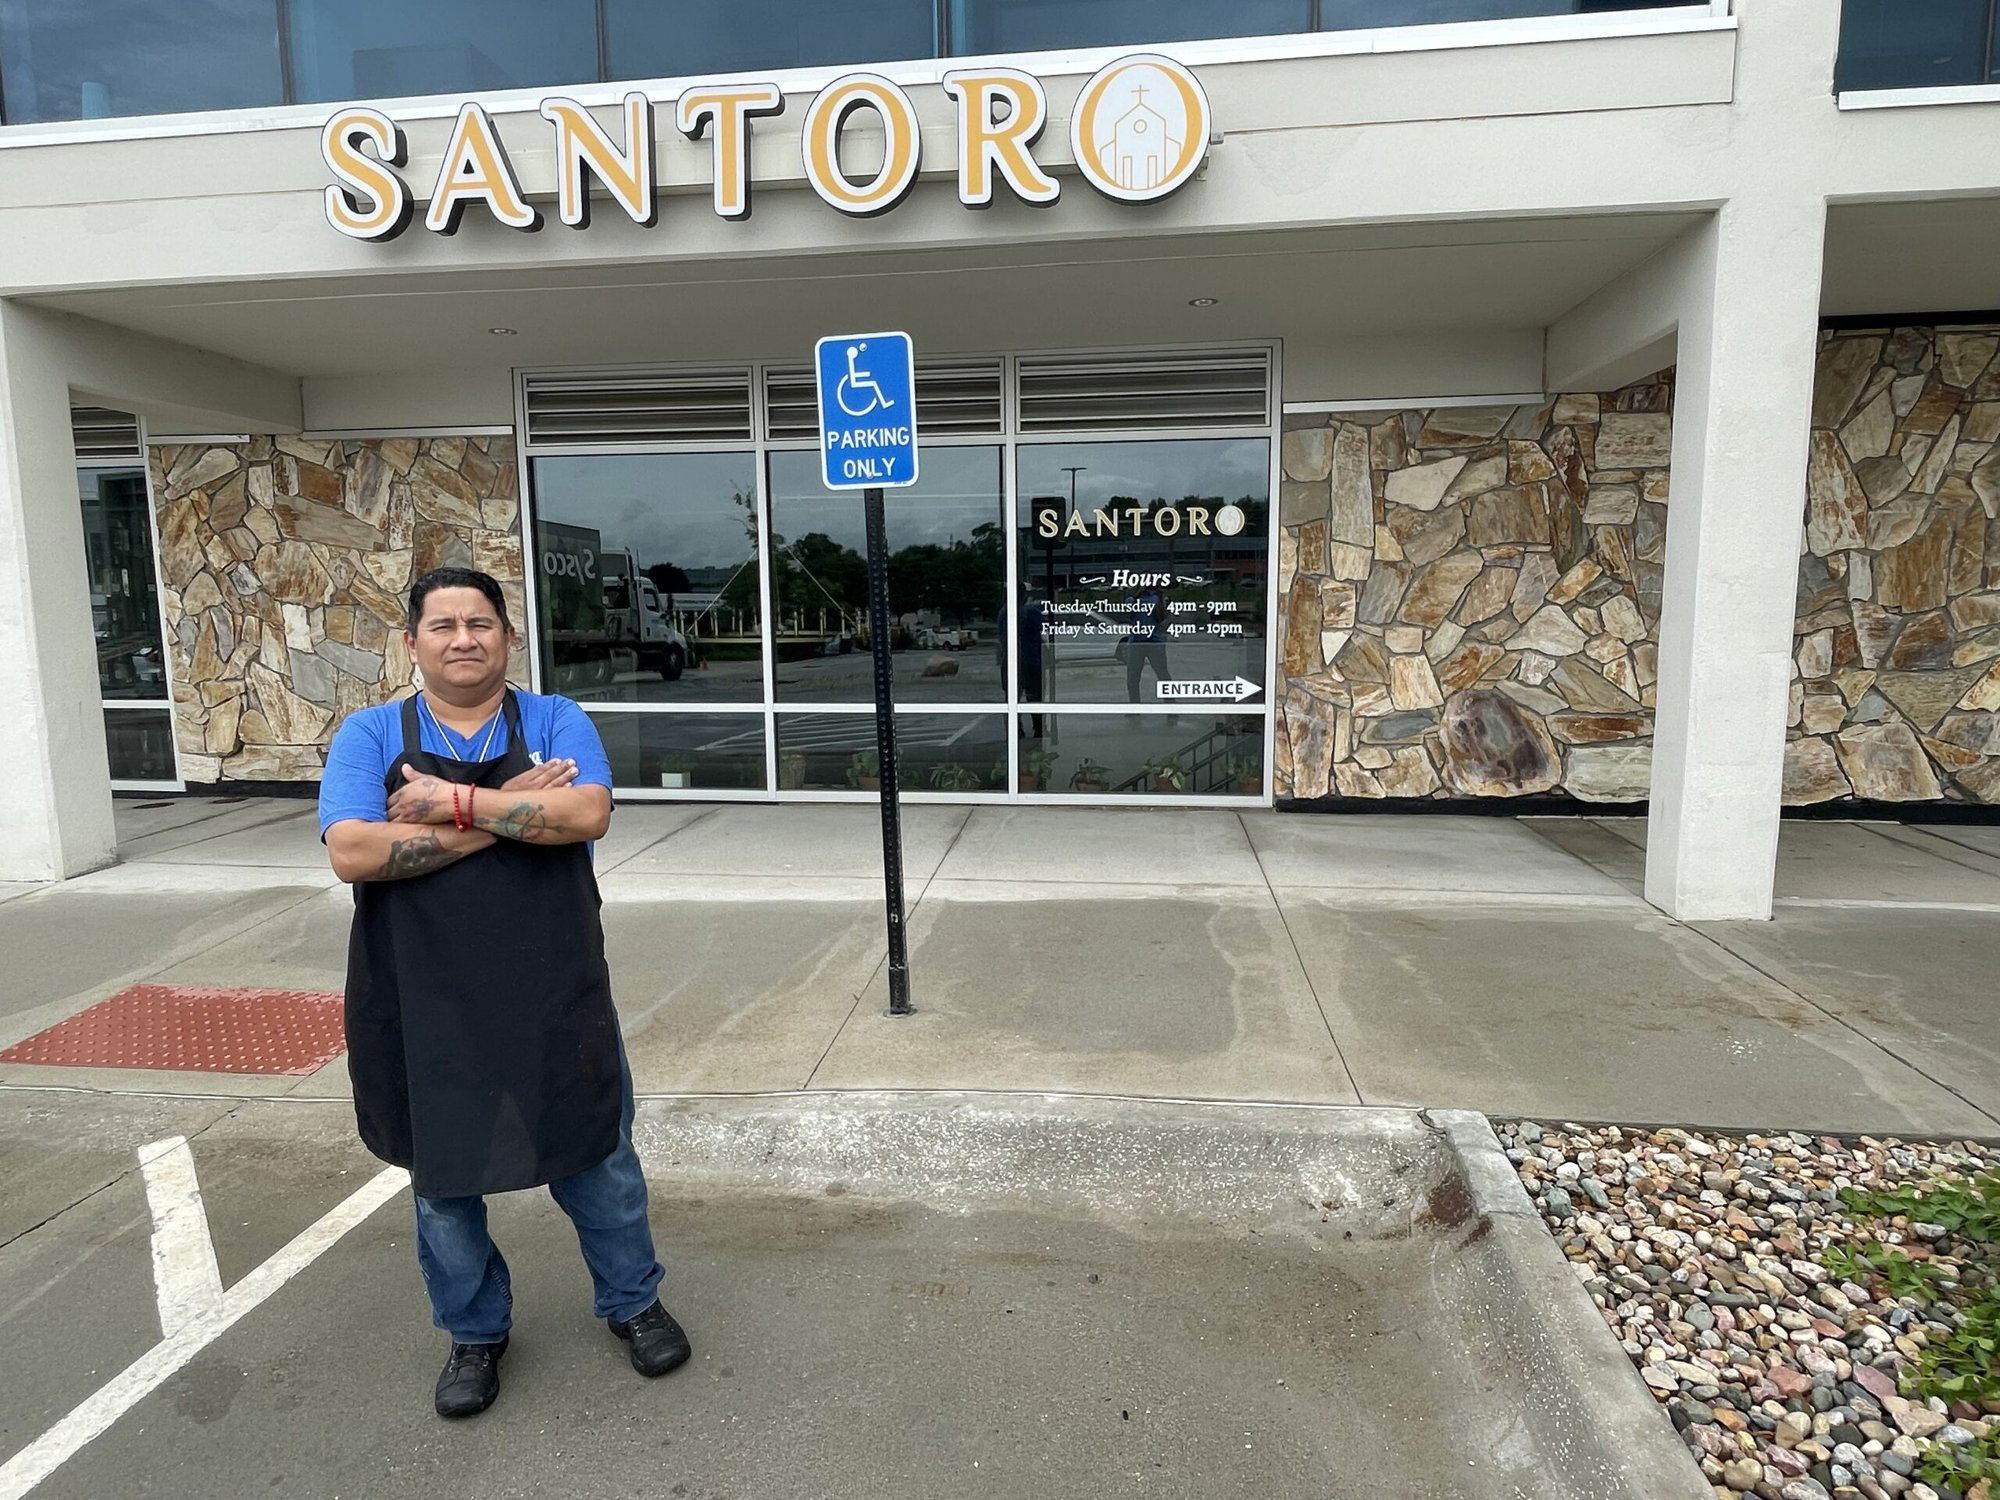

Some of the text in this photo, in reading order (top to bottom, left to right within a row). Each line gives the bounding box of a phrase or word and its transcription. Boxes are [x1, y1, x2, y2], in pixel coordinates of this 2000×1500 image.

[321, 54, 1212, 241] SANTORO
[827, 427, 910, 449] PARKING
[843, 457, 896, 479] ONLY
[1038, 504, 1246, 538] SANTORO
[1111, 569, 1171, 587] Hours
[1041, 600, 1155, 616] Tuesday-Thursday
[1166, 601, 1198, 615] 4pm
[1207, 601, 1237, 615] 9pm
[1041, 622, 1080, 638] Friday
[1083, 624, 1095, 635] &
[1097, 622, 1155, 638] Saturday
[1166, 623, 1198, 638] 4pm
[1207, 623, 1243, 638] 10pm
[1161, 682, 1244, 695] ENTRANCE
